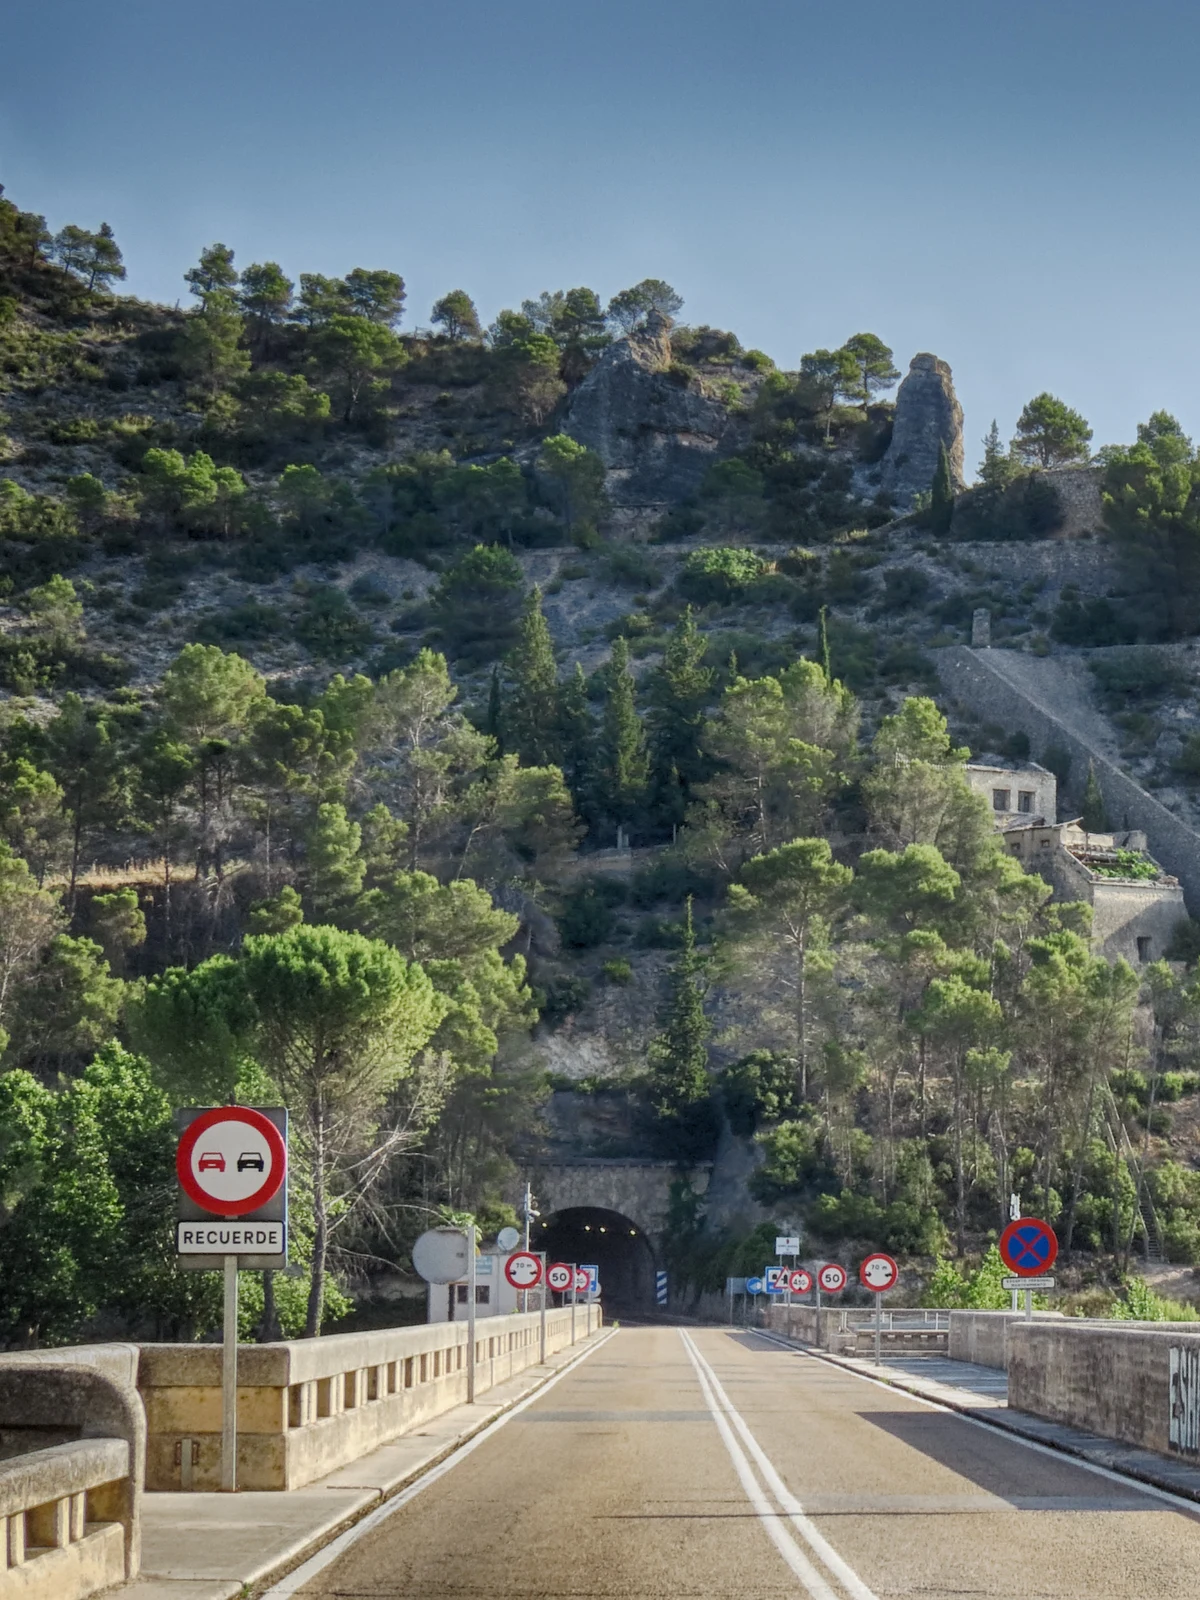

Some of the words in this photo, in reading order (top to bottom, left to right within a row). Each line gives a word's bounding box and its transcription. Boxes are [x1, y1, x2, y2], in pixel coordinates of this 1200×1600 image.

[183, 1231, 278, 1244] RECUERDE
[552, 1273, 567, 1282] 50
[825, 1273, 840, 1283] 50
